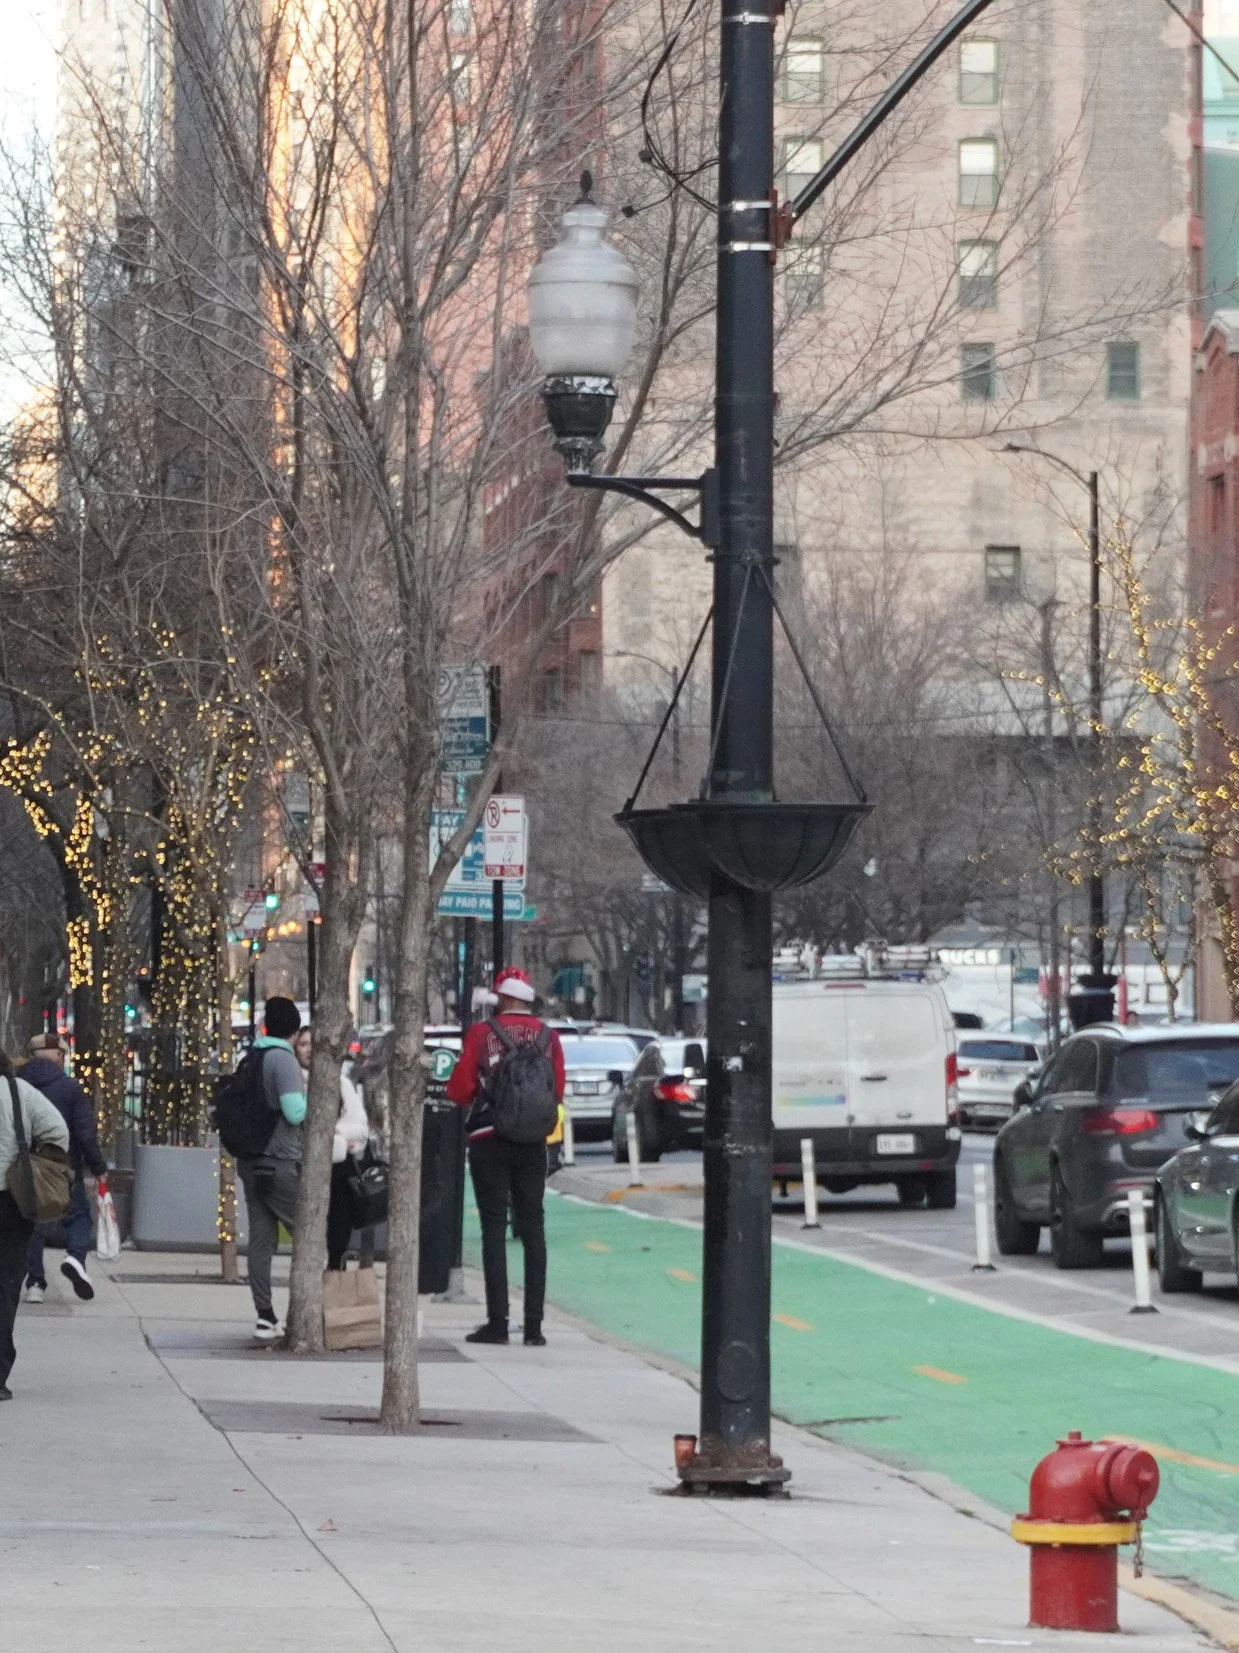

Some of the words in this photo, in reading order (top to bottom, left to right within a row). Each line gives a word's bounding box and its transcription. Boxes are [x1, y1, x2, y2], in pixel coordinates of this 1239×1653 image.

[487, 865, 501, 876] TOW
[503, 865, 521, 877] ZONE
[455, 896, 478, 908] PAID
[479, 897, 521, 910] PAING
